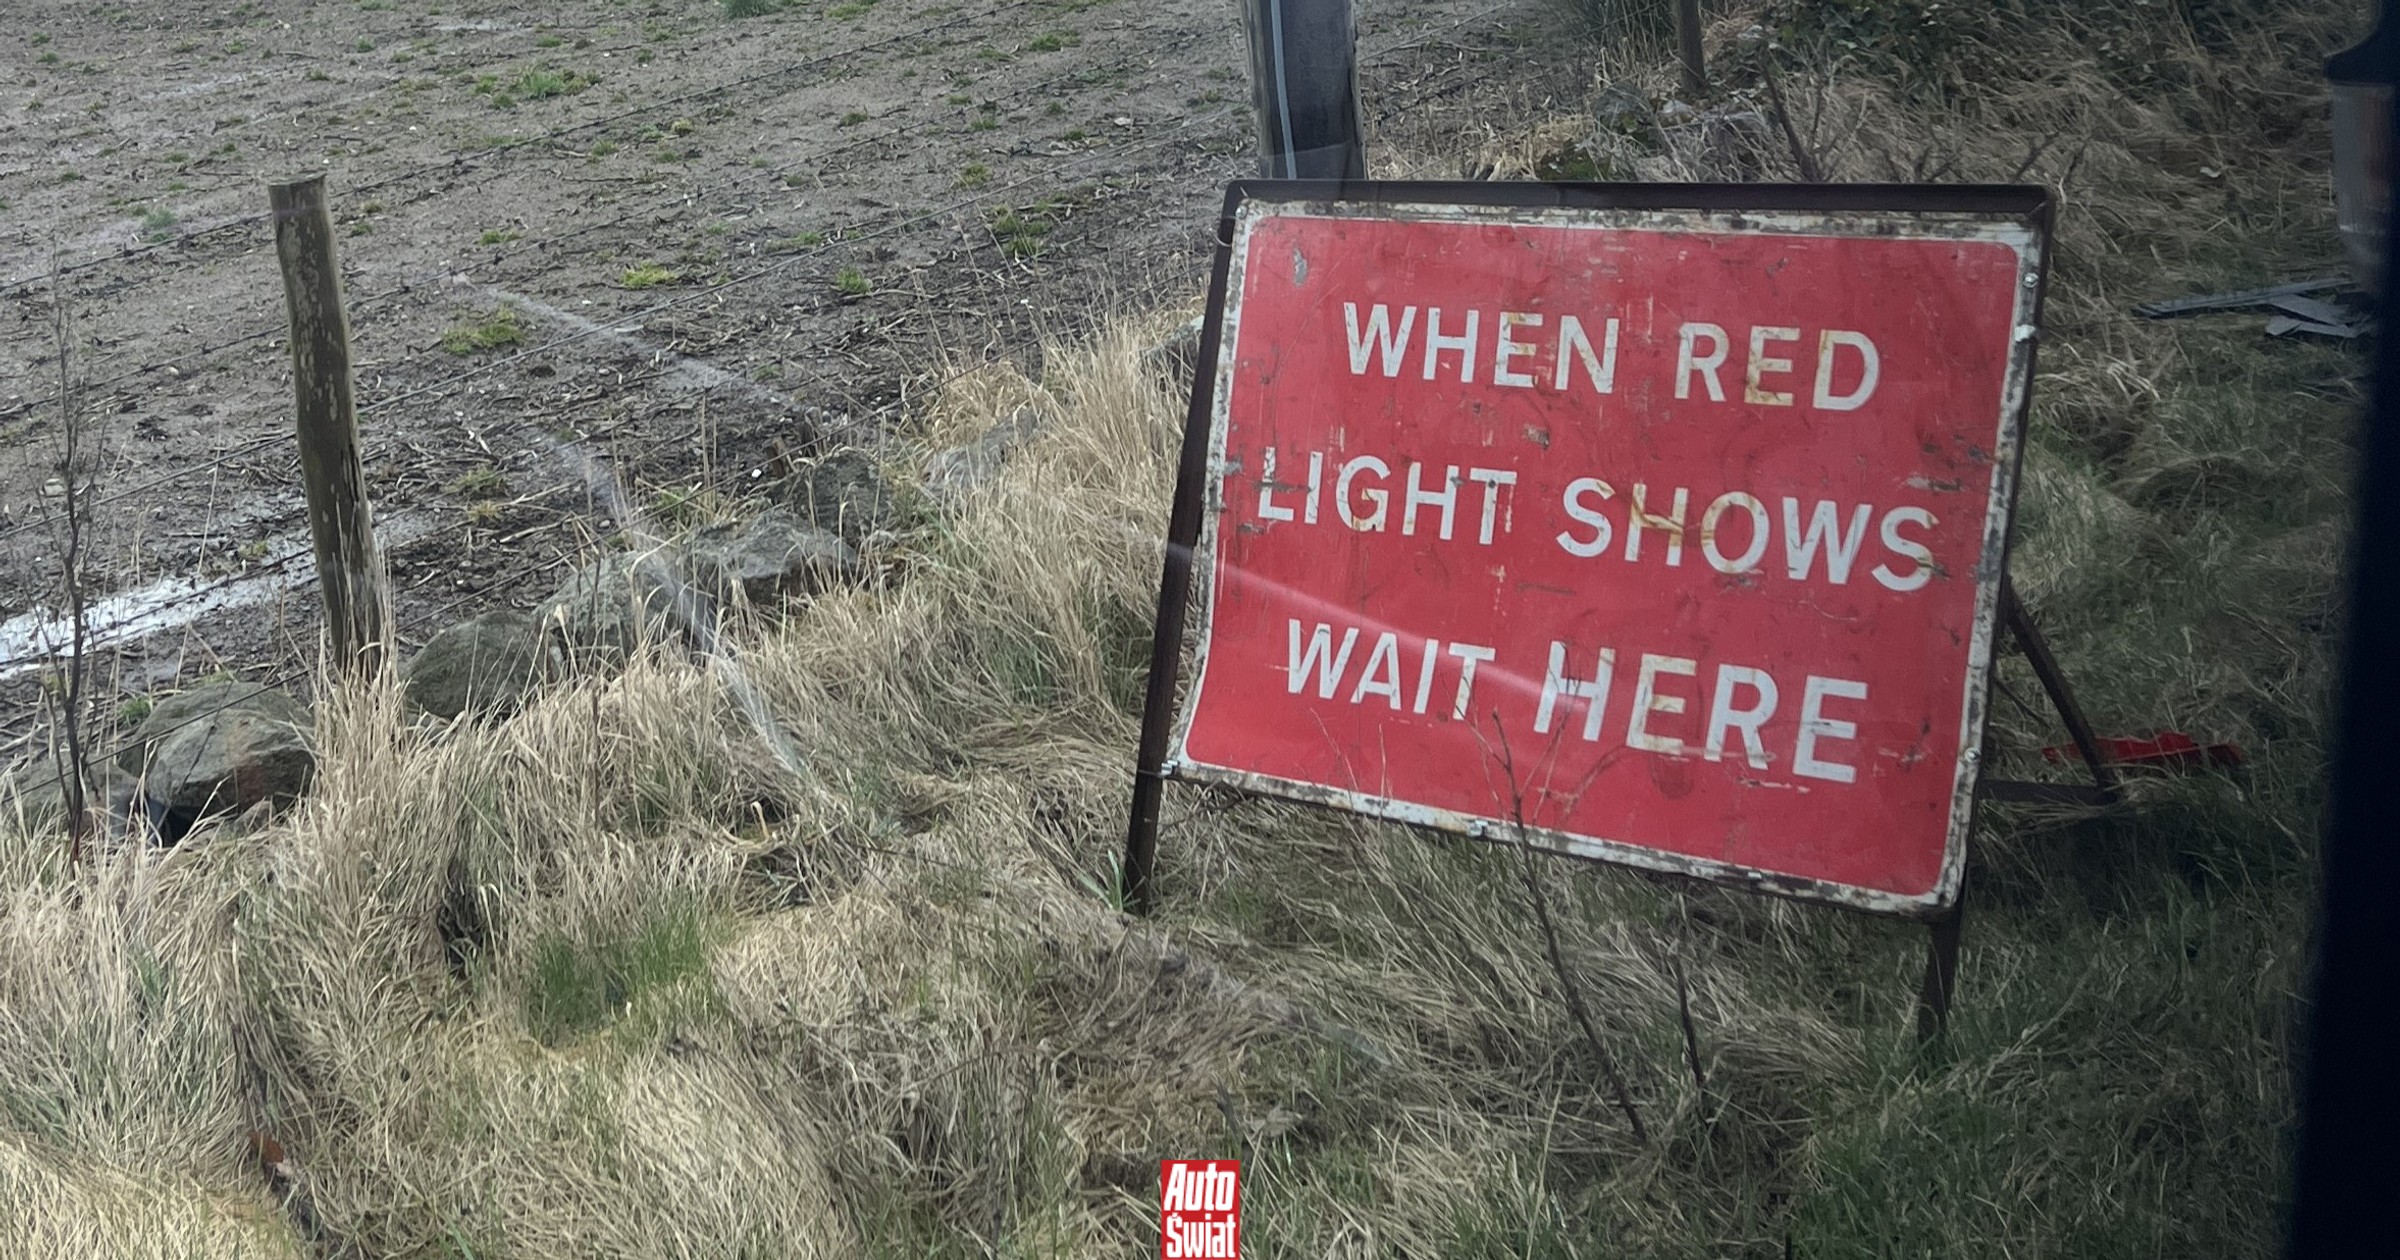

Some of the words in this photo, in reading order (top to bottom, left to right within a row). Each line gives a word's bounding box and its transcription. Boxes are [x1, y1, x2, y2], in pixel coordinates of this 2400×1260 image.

[1343, 302, 1620, 394] WHEN
[1674, 322, 1881, 411] RED
[1257, 447, 1517, 545] LIGHT
[1555, 477, 1940, 592] SHOWS
[1286, 618, 1495, 720] WAIT
[1533, 641, 1868, 783] HERE
